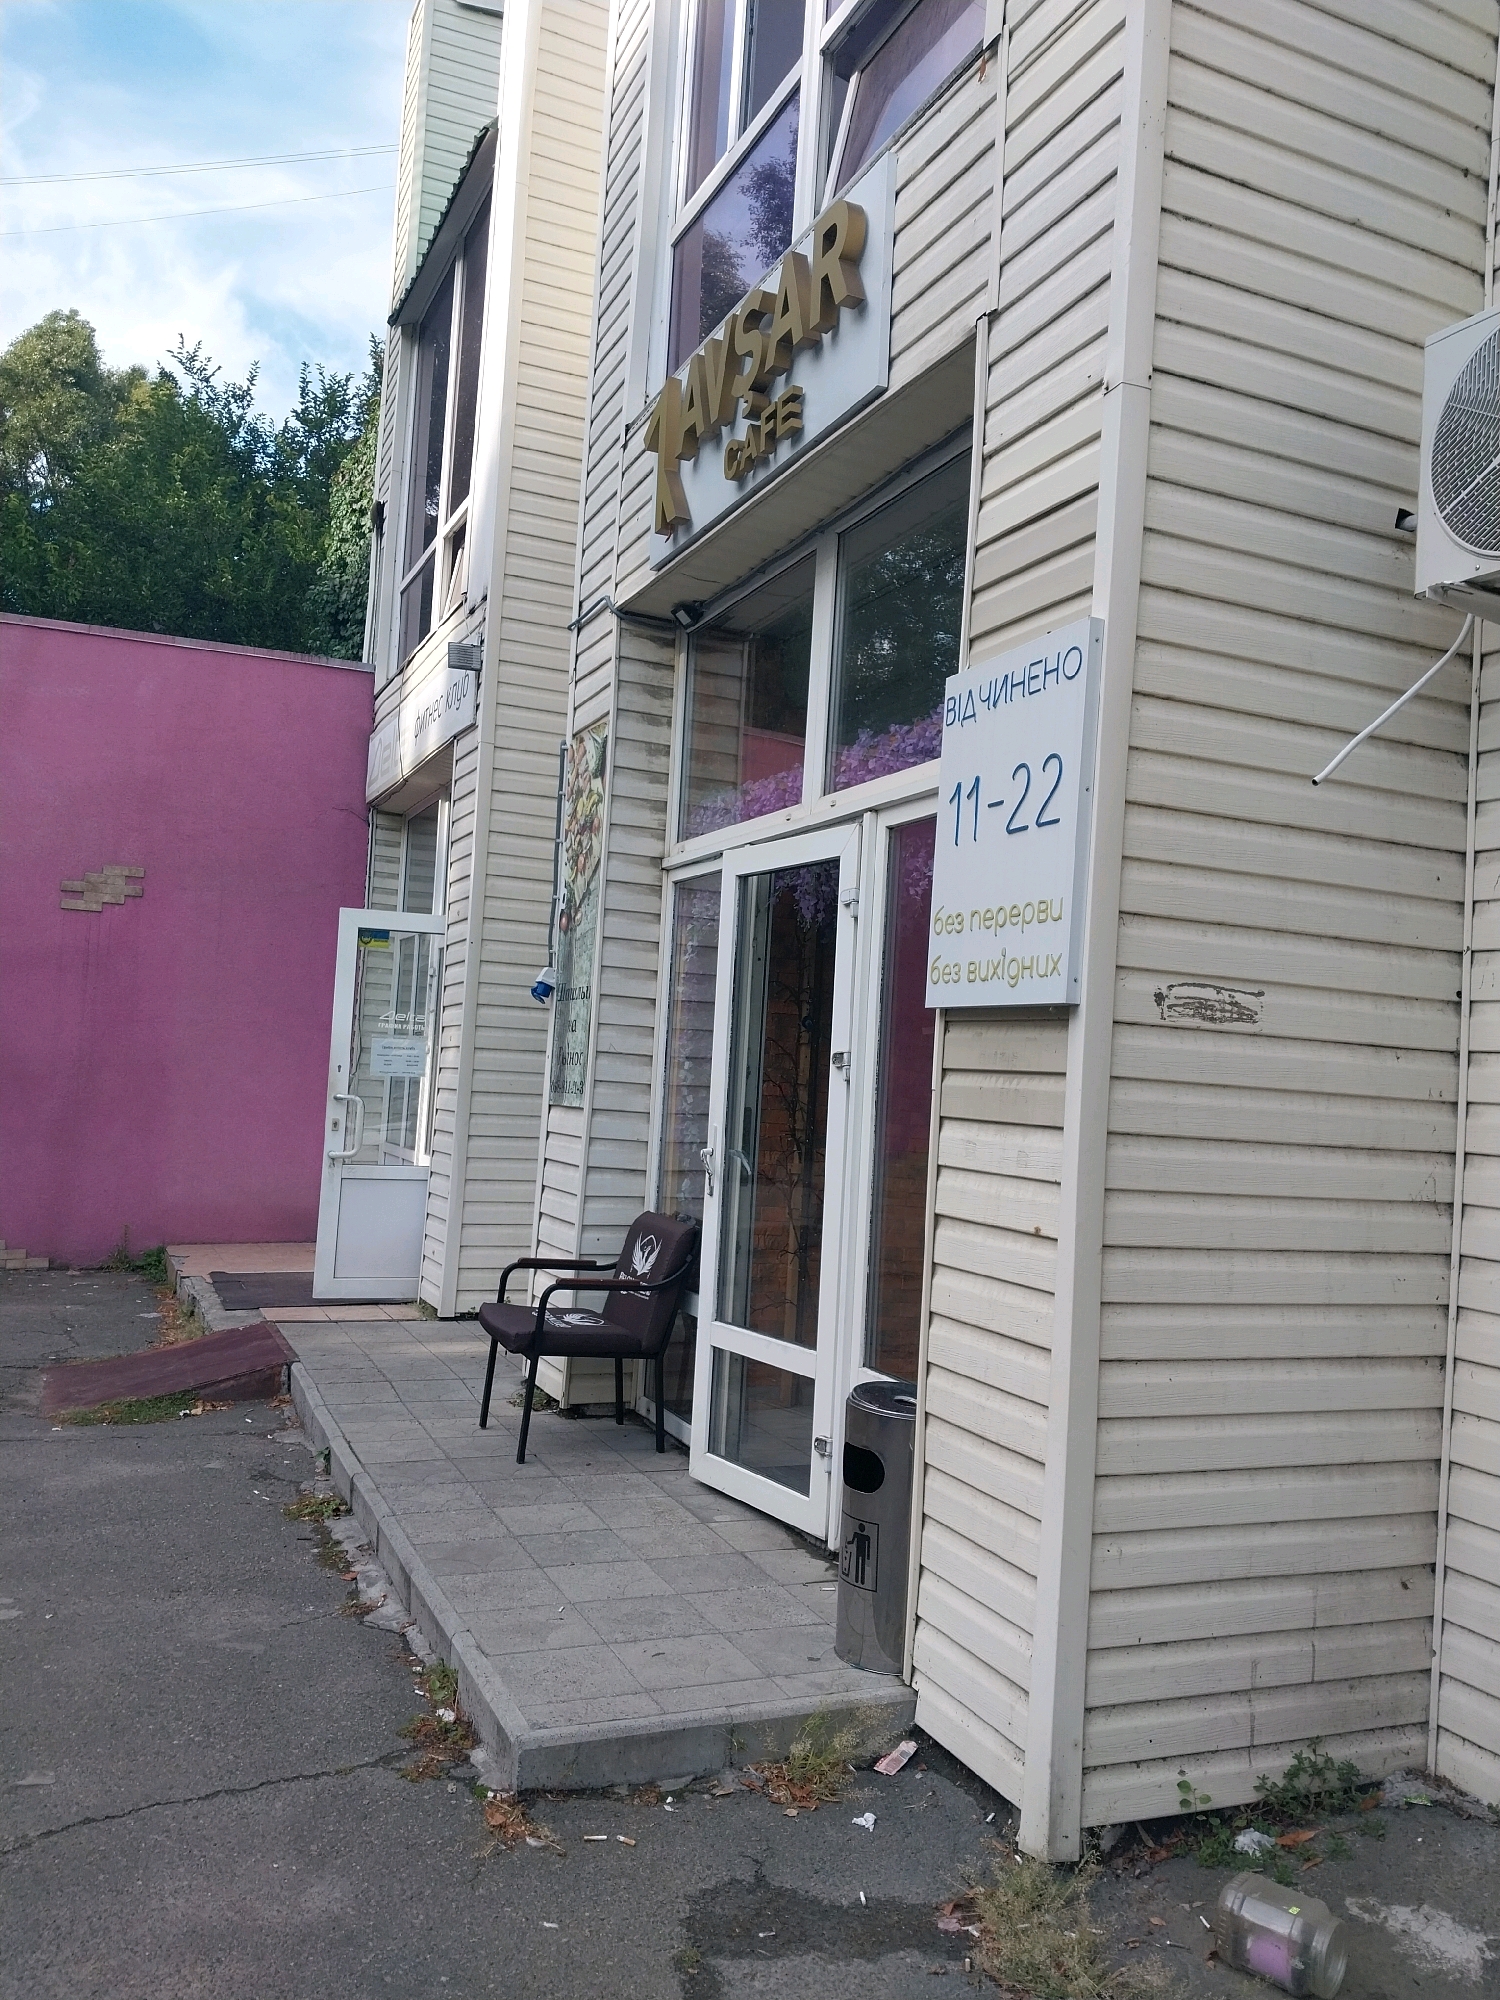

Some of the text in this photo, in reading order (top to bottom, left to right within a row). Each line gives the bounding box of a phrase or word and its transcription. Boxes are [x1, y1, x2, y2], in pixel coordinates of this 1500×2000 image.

[724, 385, 804, 481] CAFE
[945, 645, 1083, 728] ВІДЧИНЕНО
[949, 752, 1064, 847] 11-22
[933, 898, 1064, 938] без перерви
[930, 946, 1063, 988] без вихідних
